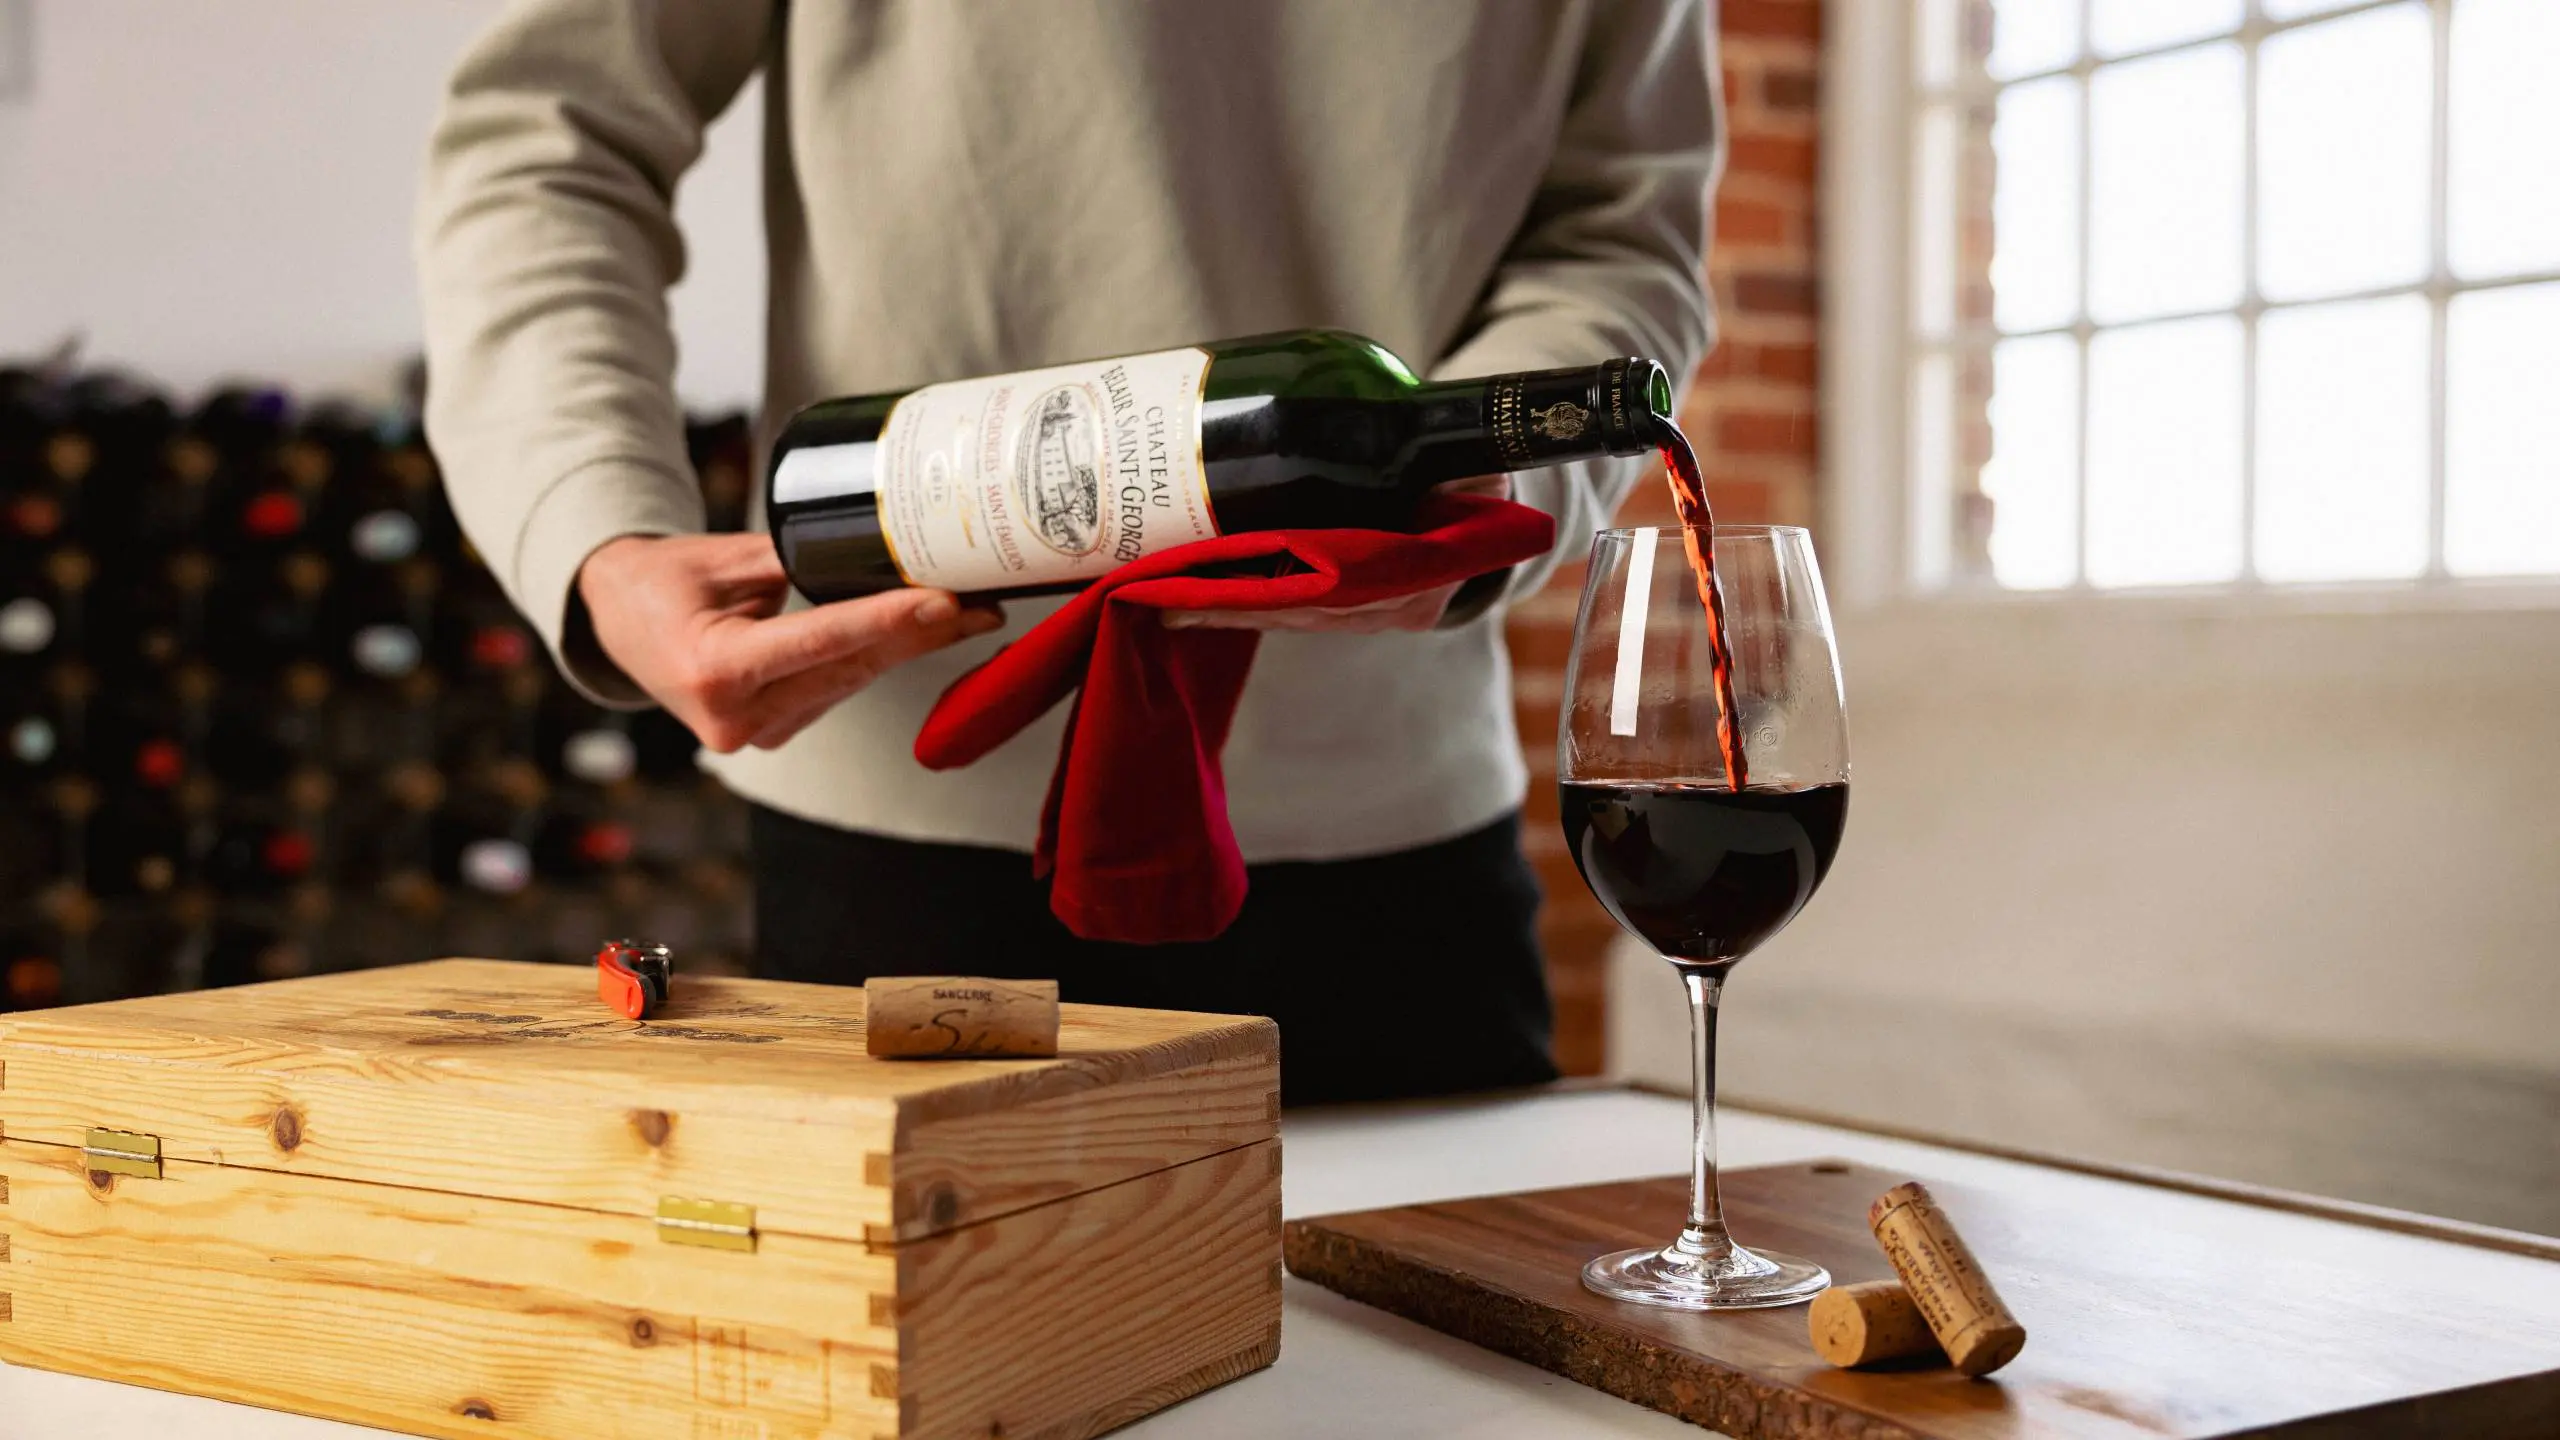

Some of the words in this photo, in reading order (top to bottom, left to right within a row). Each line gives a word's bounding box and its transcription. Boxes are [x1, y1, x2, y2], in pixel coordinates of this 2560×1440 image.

[1101, 365, 1134, 415] BELAIR
[1611, 371, 1621, 384] DE
[1500, 387, 1519, 454] CHATEAU
[1611, 388, 1624, 430] FRANCE
[1145, 406, 1170, 508] CHATEAU
[933, 988, 993, 1002] SANCERRE
